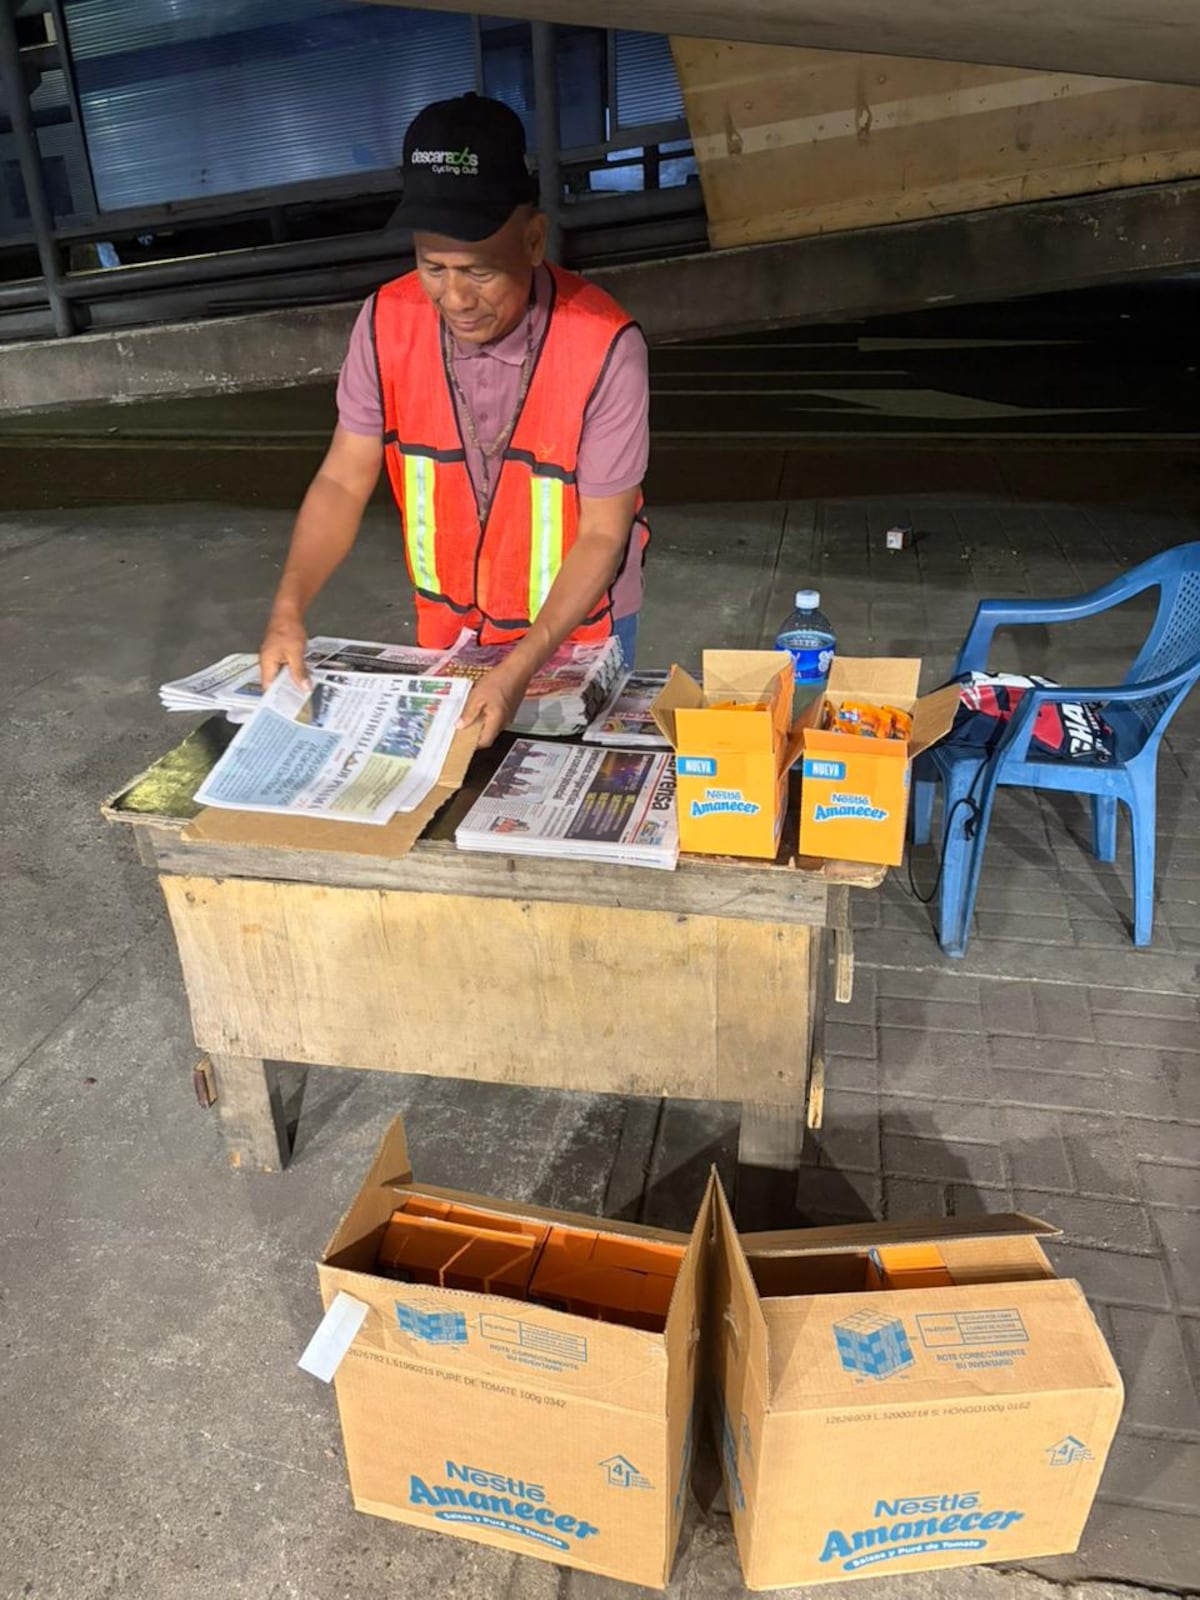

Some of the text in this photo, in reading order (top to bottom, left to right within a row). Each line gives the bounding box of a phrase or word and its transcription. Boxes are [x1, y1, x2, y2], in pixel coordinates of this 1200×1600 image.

[432, 164, 461, 175] Cycling
[706, 790, 741, 801] Nestlé
[832, 793, 869, 805] Nestlé
[692, 801, 760, 816] Amanecer
[814, 805, 888, 820] Amanecer
[464, 1377, 477, 1388] DE
[480, 1381, 517, 1397] TOMATE
[446, 1460, 546, 1503] Nestlé
[409, 1474, 600, 1540] Amanecer
[874, 1491, 981, 1518] Nestlé
[819, 1510, 1025, 1562] Amanecer
[925, 1542, 940, 1552] de
[941, 1539, 981, 1549] Tomate
